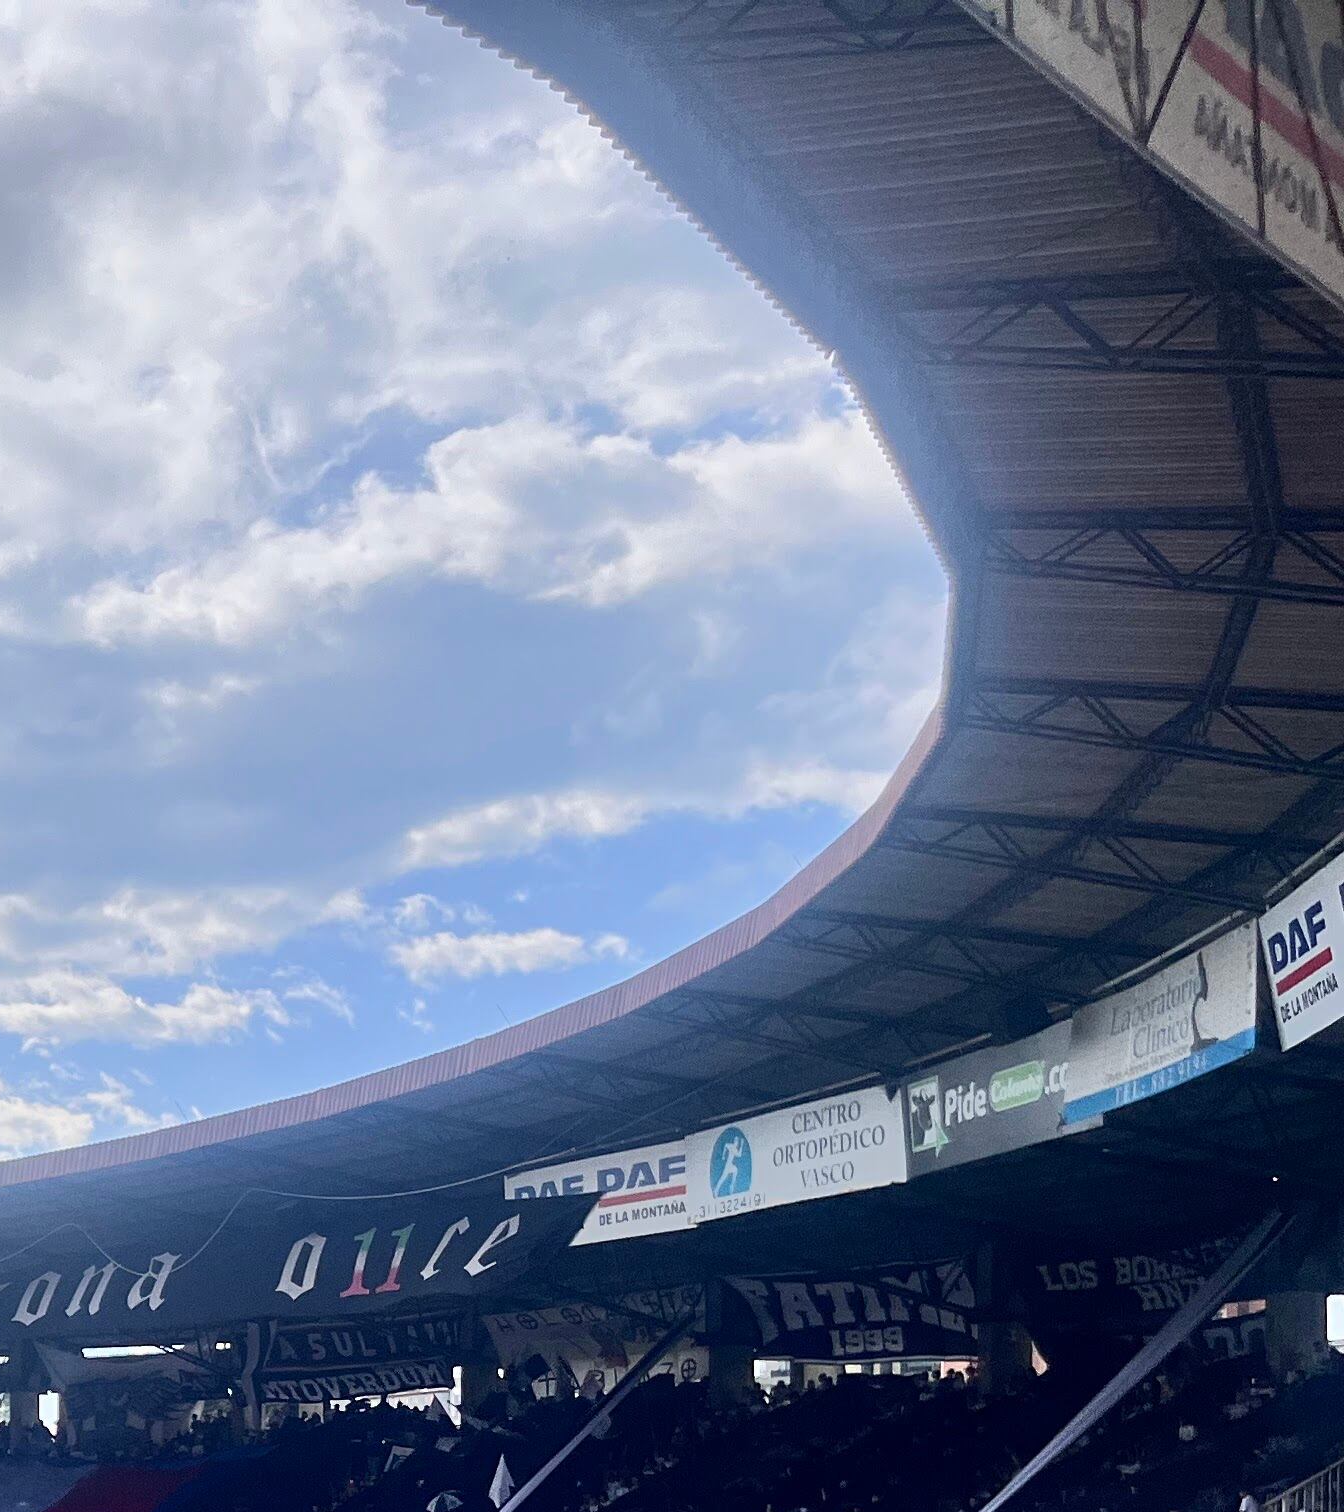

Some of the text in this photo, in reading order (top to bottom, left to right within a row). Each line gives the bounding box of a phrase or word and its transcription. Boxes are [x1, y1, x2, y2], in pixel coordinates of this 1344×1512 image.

[1268, 900, 1326, 974] DAF
[1280, 972, 1339, 1024] DE LA MONTAÑA
[792, 1101, 861, 1134] CENTRO
[945, 1081, 988, 1127] Pide
[773, 1124, 885, 1168] ORTOPÉDICO
[597, 1155, 686, 1193] DAF
[801, 1160, 855, 1188] VASCO
[599, 1202, 687, 1226] DE LA MONTAÑA
